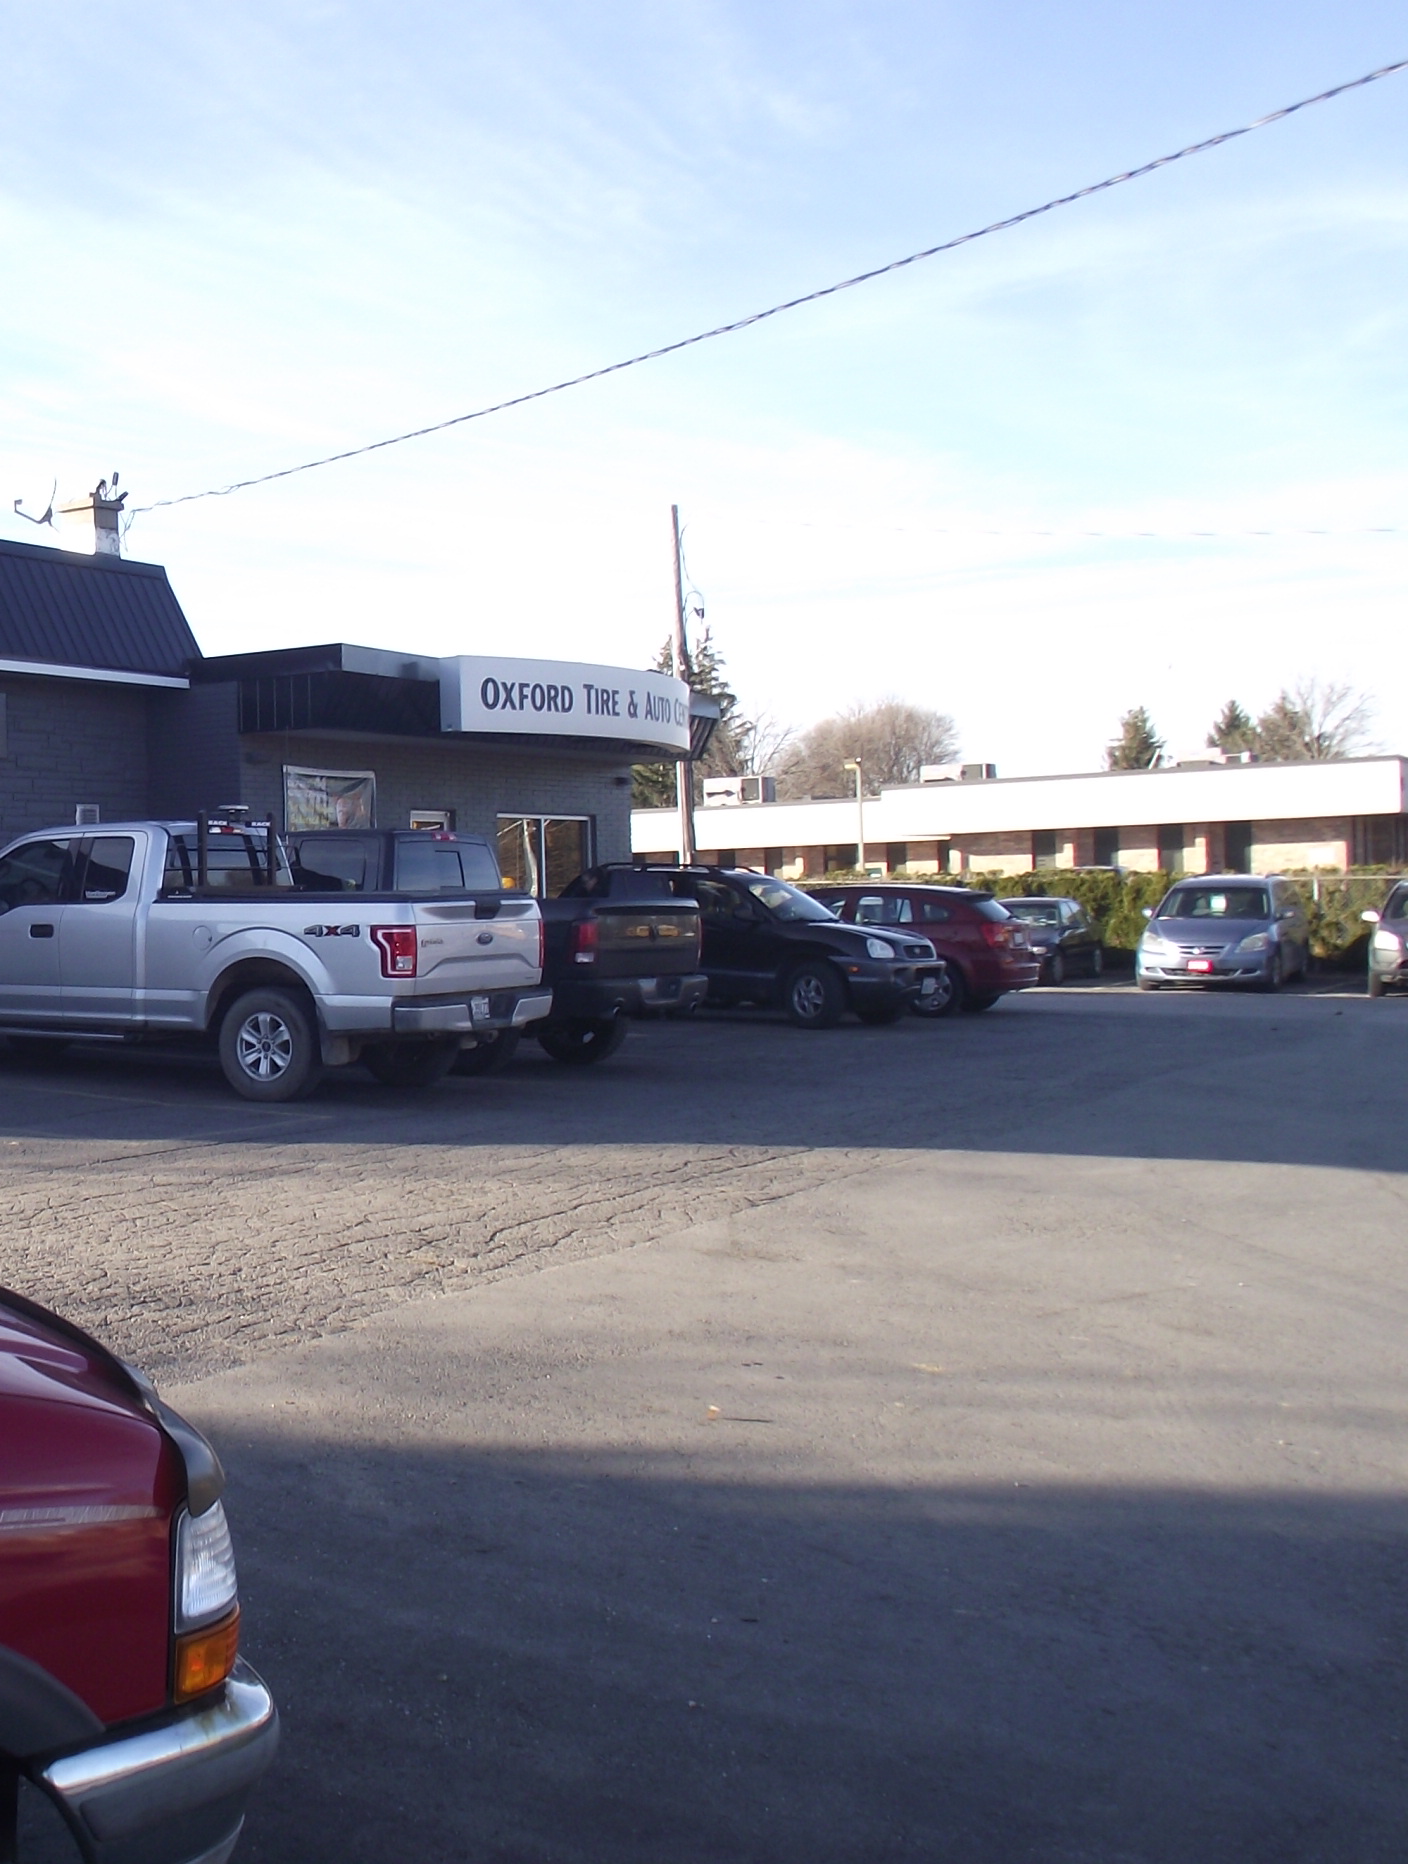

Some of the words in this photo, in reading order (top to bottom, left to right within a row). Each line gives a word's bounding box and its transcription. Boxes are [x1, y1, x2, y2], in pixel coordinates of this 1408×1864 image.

[480, 677, 574, 713] OXFORD
[582, 684, 620, 716] TIRE
[627, 690, 638, 719] &
[644, 691, 671, 725] AUTO
